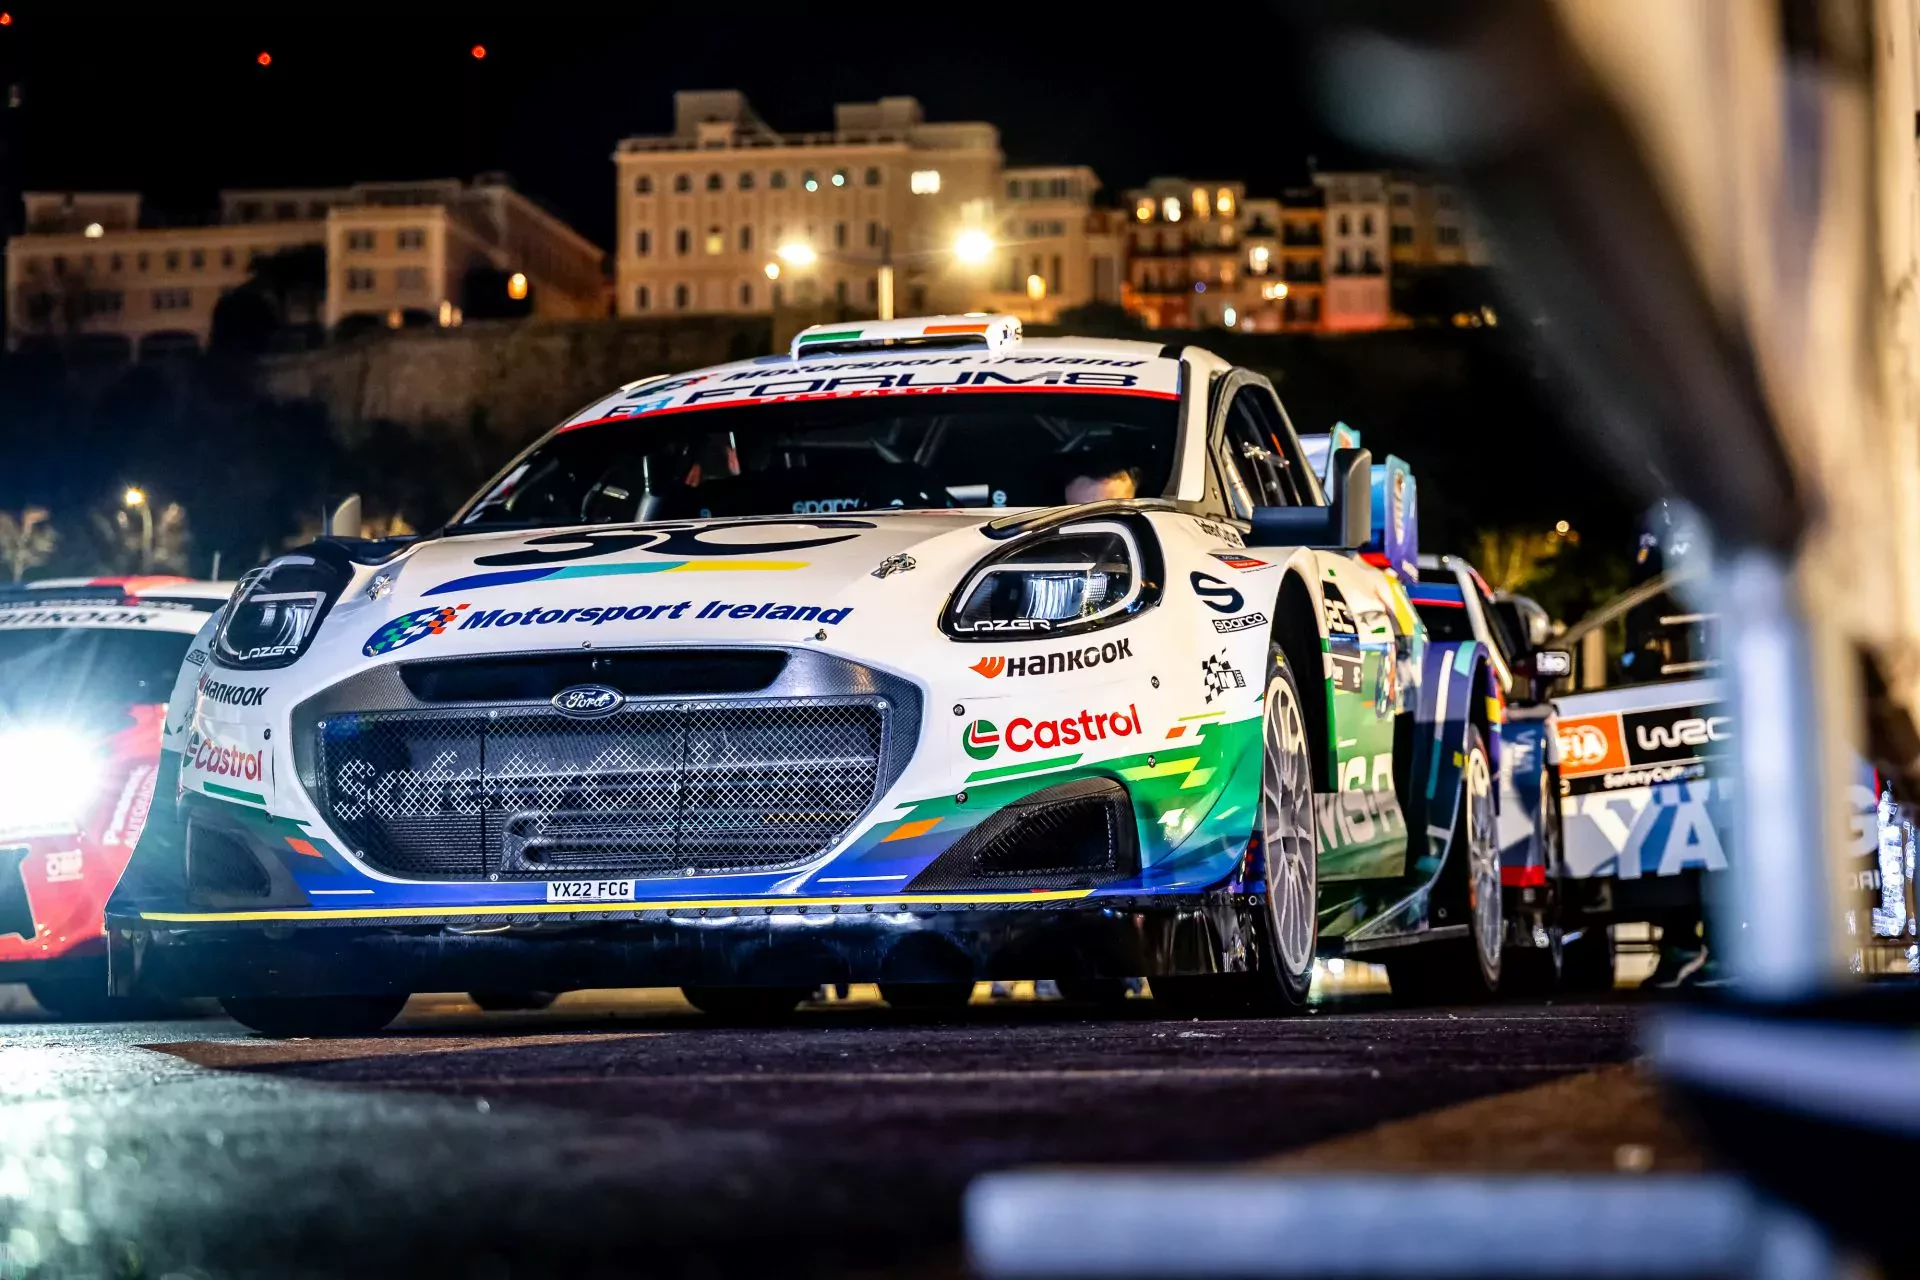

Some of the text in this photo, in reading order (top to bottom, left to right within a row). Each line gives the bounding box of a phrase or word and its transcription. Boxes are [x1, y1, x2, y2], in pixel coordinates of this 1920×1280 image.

[721, 356, 972, 382] Motorsport
[684, 371, 1139, 404] FORUM8
[457, 600, 856, 631] Motorsport Ireland
[954, 619, 1051, 632] LAZER
[1214, 613, 1265, 632] sparco
[238, 645, 299, 660] LAZER
[566, 691, 611, 708] Ford
[1005, 703, 1142, 752] Castrol
[1637, 716, 1735, 751] WRC
[195, 738, 262, 781] Castrol
[553, 882, 628, 897] YX22 FCG
